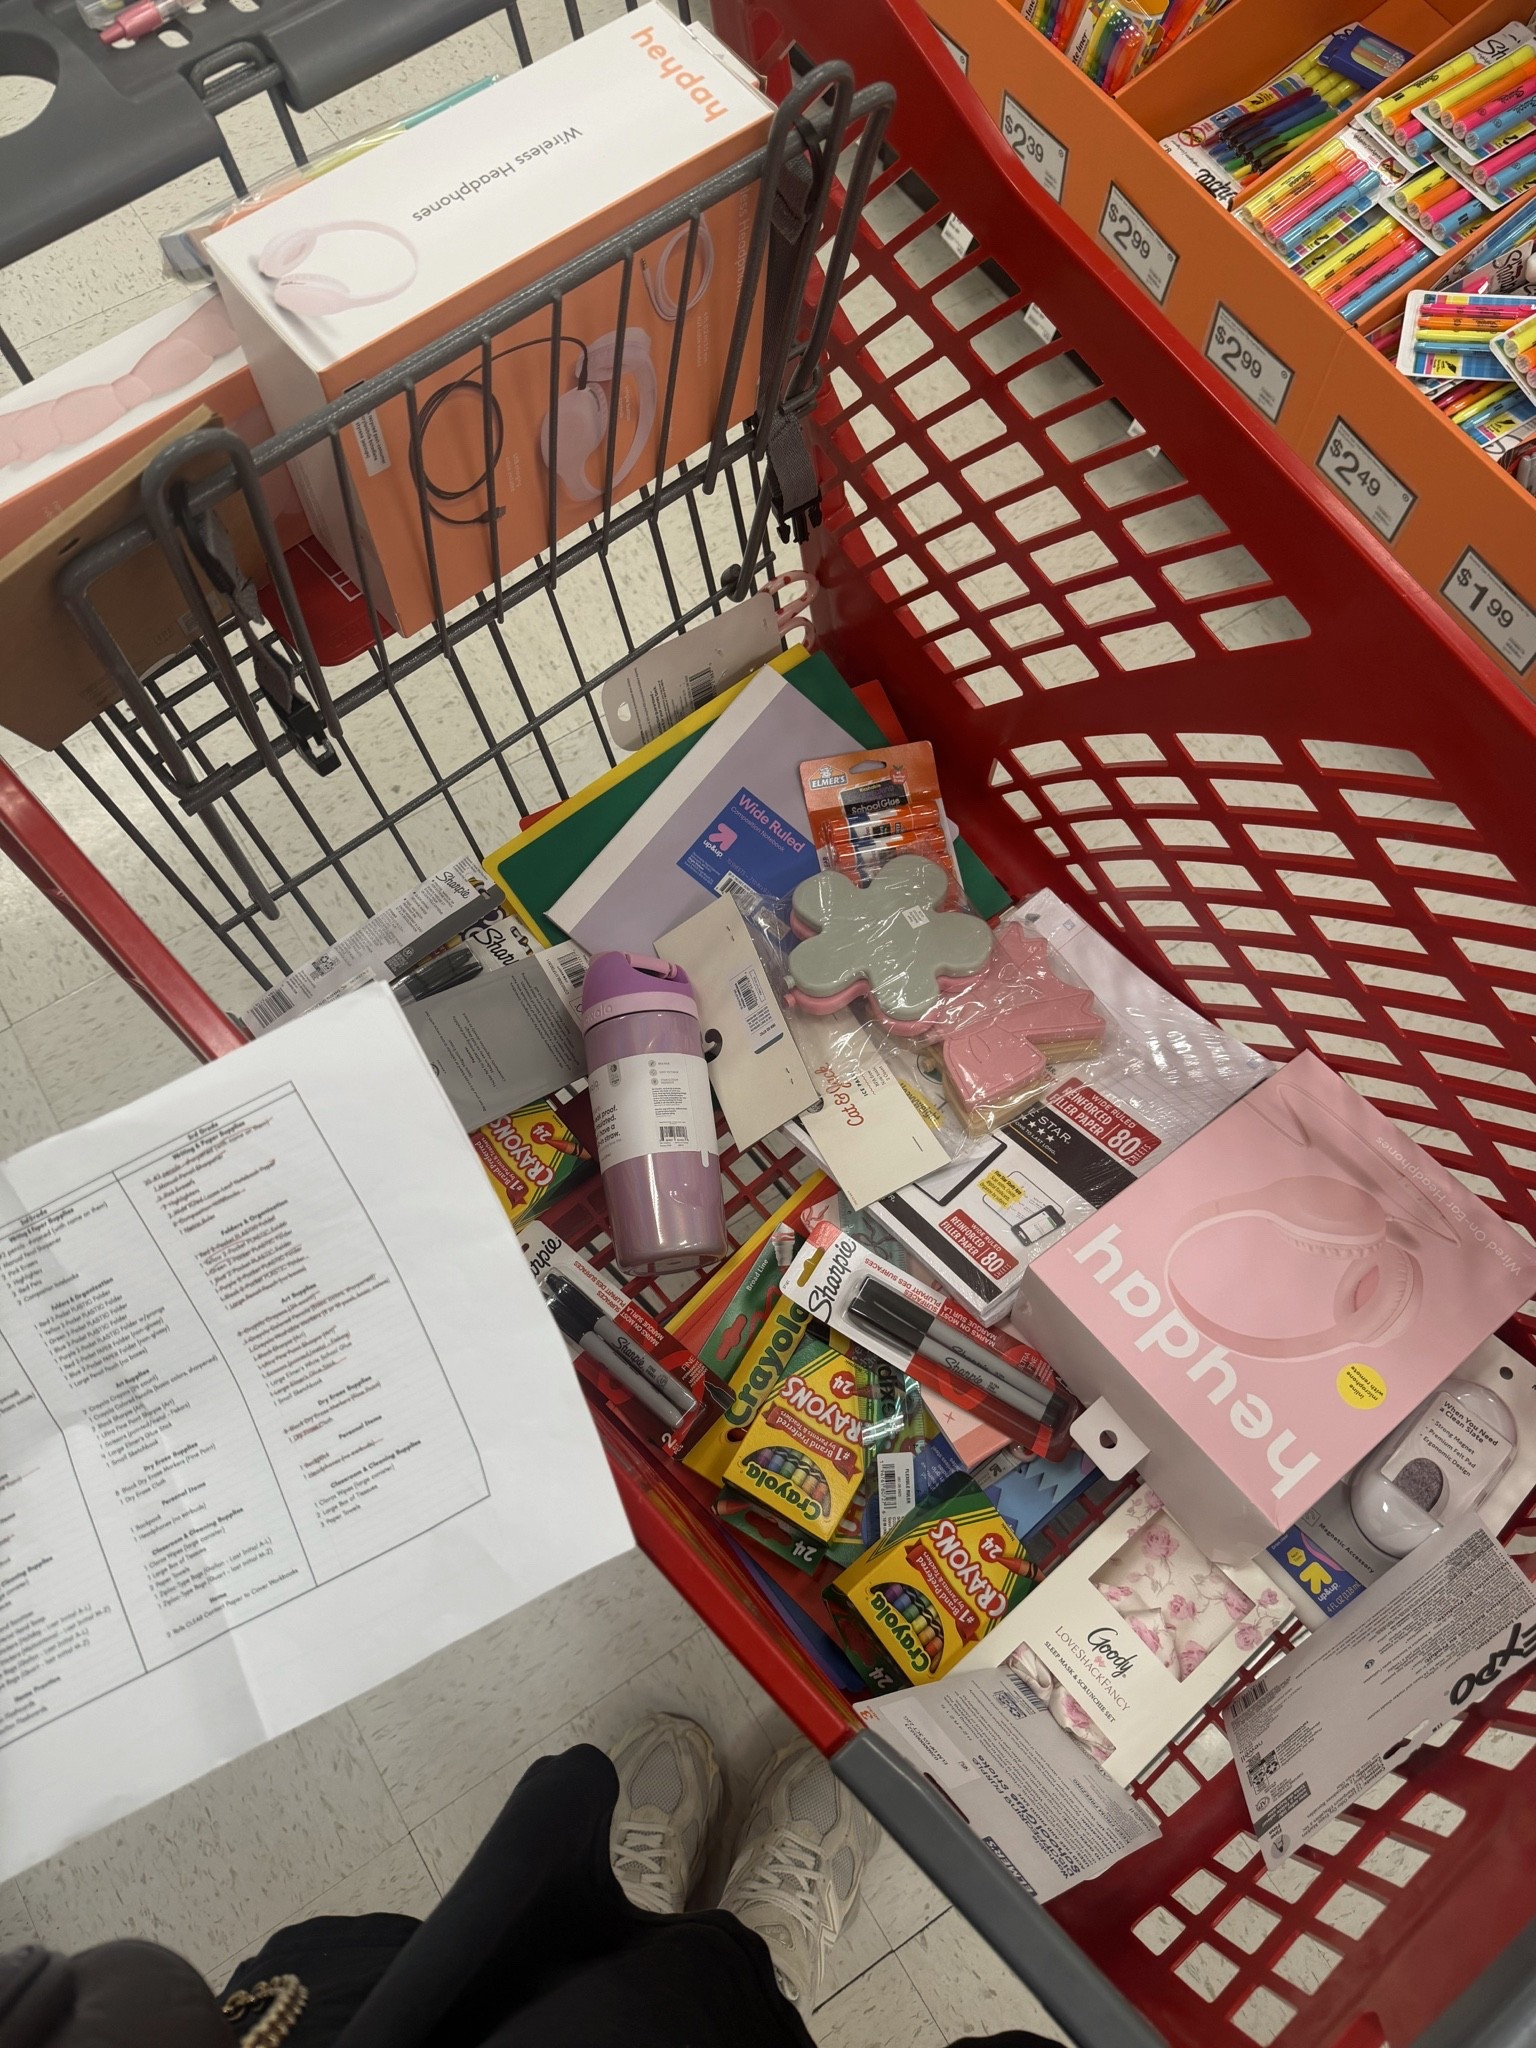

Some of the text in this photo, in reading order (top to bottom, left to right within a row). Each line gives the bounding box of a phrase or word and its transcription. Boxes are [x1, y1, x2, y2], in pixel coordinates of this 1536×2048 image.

[633, 27, 726, 121] heyday
[413, 128, 582, 220] Wireless Headphones
[812, 775, 845, 787] ELMER'S
[851, 797, 900, 813] School Glue
[729, 805, 785, 850] Composition Notebook
[737, 794, 805, 852] Wide Ruled
[701, 838, 724, 858] up&up
[435, 867, 472, 902] Sharpie
[815, 1057, 864, 1126] Cat & Jack
[1062, 1088, 1113, 1125] REINFORCED
[1049, 1094, 1104, 1136] FILLER PAPER
[1091, 1092, 1136, 1129] WIDE RULED
[200, 1120, 219, 1133] Grade
[532, 1123, 551, 1143] 24
[1038, 1116, 1071, 1142] STAR
[1106, 1125, 1142, 1159] 80
[480, 1135, 497, 1156] Teachers
[475, 1139, 510, 1186] Brand Preferred
[497, 1157, 510, 1175] Parents
[506, 1171, 516, 1181] by
[508, 1178, 524, 1193] #1
[221, 1219, 243, 1235] Folders
[249, 1200, 287, 1221] Organization
[1374, 1134, 1523, 1279] Wired On-Ear Headphones
[938, 1219, 979, 1256] FILLER PAPER
[947, 1215, 987, 1248] REINFORCED
[969, 1222, 1003, 1251] WIDE RULED
[572, 1259, 598, 1282] SURFACES
[746, 1259, 771, 1292] Broad Line
[979, 1249, 1005, 1274] 80
[279, 1280, 318, 1304] Art Supplies
[594, 1278, 608, 1291] DES
[605, 1287, 627, 1307] PLUPART
[800, 1242, 855, 1322] Sharpie
[630, 1310, 644, 1323] SUR
[870, 1262, 997, 1340] MARQUE SUR LA PLUPART DES SURFACES
[595, 1289, 660, 1347] MARKS ON MOST SURFACES
[641, 1319, 665, 1341] MARQUE
[902, 1288, 995, 1347] MARKS ON MOST SURFACES
[612, 1333, 649, 1368] Sharpie
[680, 1355, 695, 1372] FINE
[711, 1302, 820, 1427] Crayola
[1071, 1221, 1322, 1500] heyday
[829, 1373, 853, 1394] 24
[941, 1356, 985, 1388] Sharpie
[1347, 1372, 1381, 1400] microphone
[1351, 1366, 1383, 1397] with remote
[316, 1375, 371, 1407] Dry Erase Supplies
[1349, 1384, 1364, 1399] inline
[339, 1412, 383, 1439] Personal Items
[779, 1410, 802, 1429] Teachers
[1444, 1401, 1498, 1446] When You Need
[1445, 1411, 1464, 1428] Clean
[1466, 1426, 1486, 1442] Slate
[659, 1431, 677, 1448] 2
[776, 1416, 833, 1457] Brand Preferred
[805, 1425, 829, 1446] Parents
[826, 1440, 838, 1452] by
[1429, 1429, 1476, 1468] Premium Felt Pad
[1435, 1421, 1474, 1454] Strong Magnet
[831, 1445, 851, 1465] #1
[1423, 1436, 1470, 1476] Ergonomic Design
[744, 1455, 822, 1522] Crayola
[792, 1537, 820, 1564] 24
[976, 1534, 1004, 1561] 24
[1319, 1523, 1374, 1573] Magnetic Accessory
[920, 1552, 939, 1577] Teachers
[928, 1516, 1009, 1621] CRAYONS
[916, 1557, 960, 1617] Brand Preferred
[942, 1578, 958, 1604] Parents
[1316, 1580, 1338, 1603] up&up
[955, 1599, 965, 1610] by
[955, 1608, 976, 1627] #1
[868, 1590, 931, 1673] Crayola
[1081, 1621, 1141, 1681] Goody
[867, 1663, 894, 1690] 24
[1042, 1640, 1062, 1658] SLEEP
[1059, 1656, 1074, 1674] MASK
[1077, 1679, 1106, 1712] SCRUNCHIE
[1102, 1710, 1116, 1723] SET
[1239, 1740, 1264, 1762] newell
